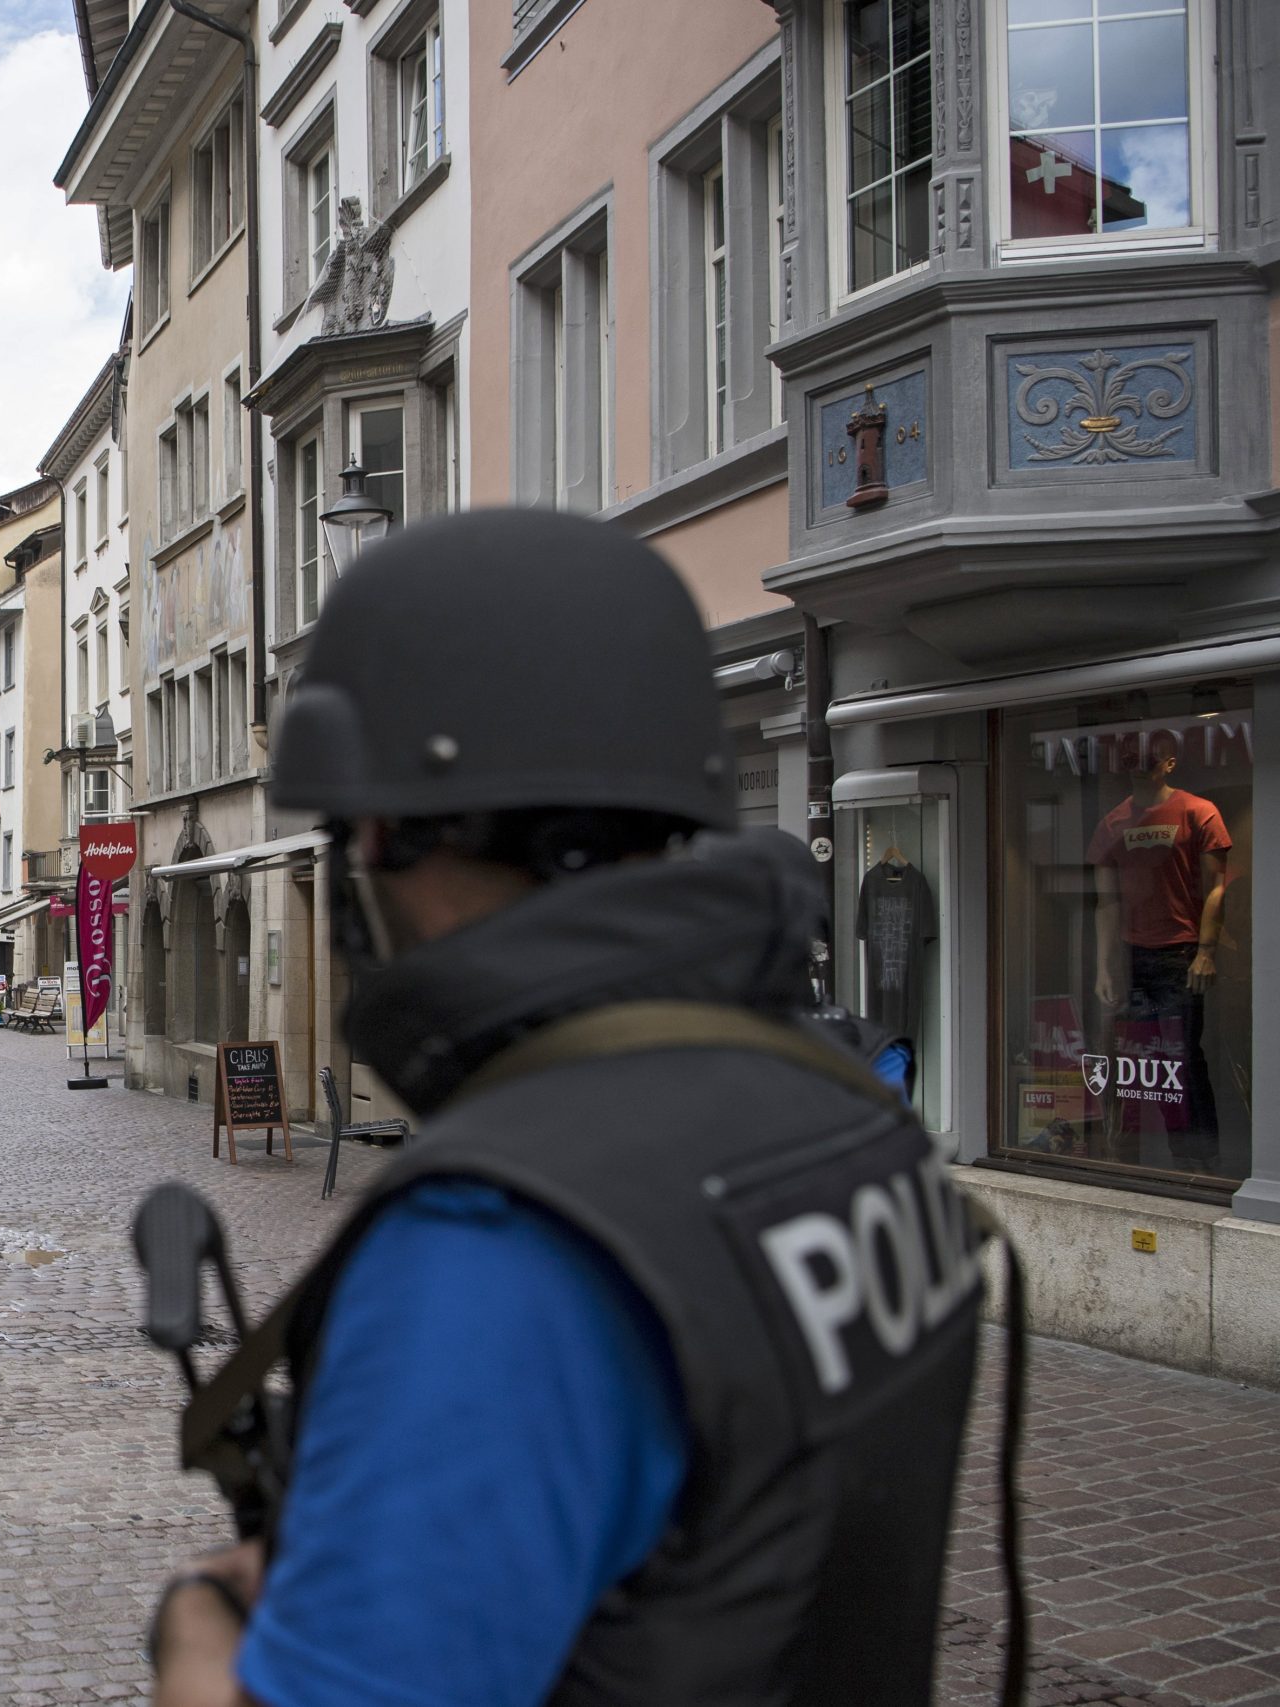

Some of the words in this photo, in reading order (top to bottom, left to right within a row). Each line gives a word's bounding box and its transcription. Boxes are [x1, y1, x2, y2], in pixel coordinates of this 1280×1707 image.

[84, 842, 134, 859] Hotelplan
[229, 1048, 269, 1064] CIBUS
[1116, 1057, 1183, 1090] DUX
[1117, 1089, 1141, 1099] MODE
[1144, 1091, 1162, 1101] SEIT
[1164, 1093, 1183, 1104] 1947
[758, 1160, 982, 1394] POLI
